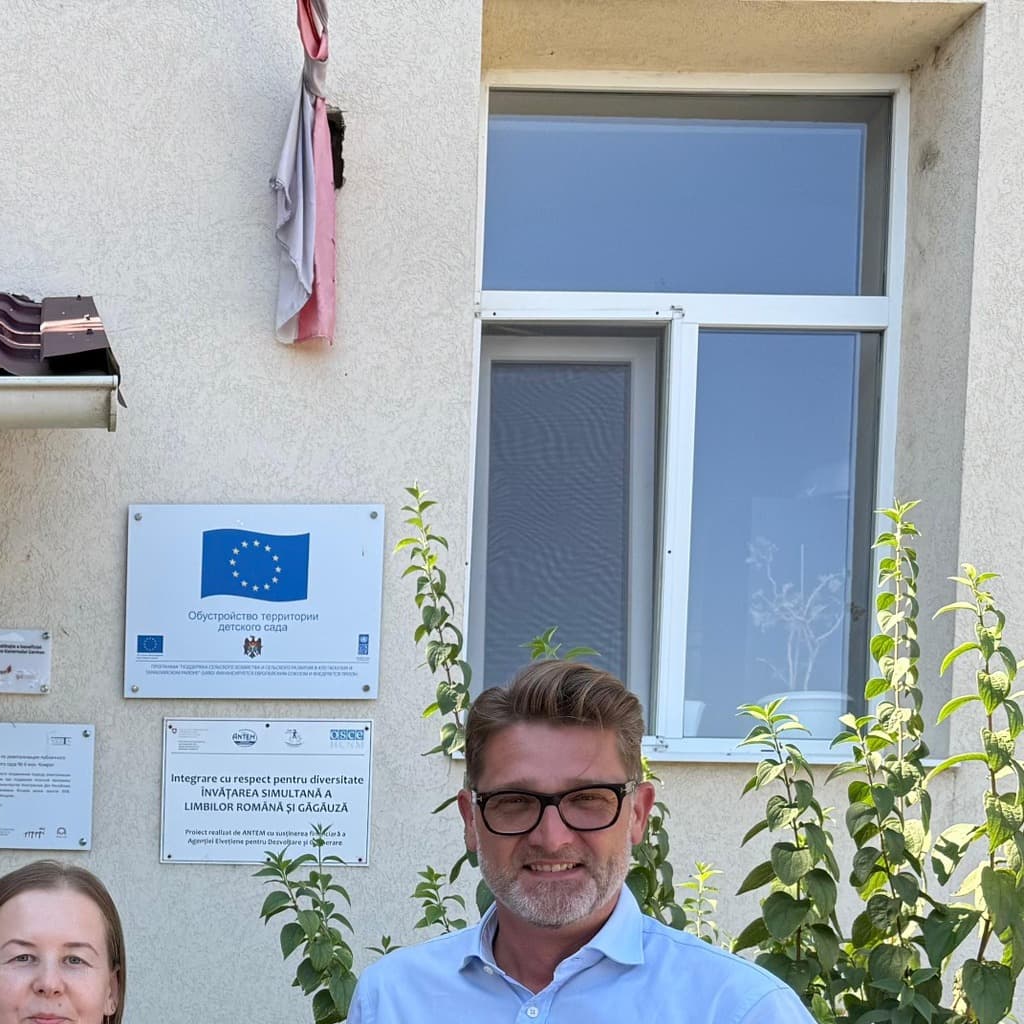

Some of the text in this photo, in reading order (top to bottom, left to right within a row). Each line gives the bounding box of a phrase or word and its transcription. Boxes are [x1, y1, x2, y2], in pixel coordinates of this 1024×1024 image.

[188, 610, 318, 622] Обустройство территории
[218, 624, 288, 632] детского сада
[232, 732, 256, 740] ANTEM
[171, 774, 218, 785] Integrare
[233, 775, 271, 785] respect
[273, 776, 307, 785] pentru
[310, 774, 364, 784] diversitate
[261, 788, 322, 798] SIMULTANĂ
[324, 790, 332, 798] A
[184, 802, 234, 811] LIMBILOR
[236, 801, 284, 812] ROMÂNĂ
[298, 802, 349, 812] GĂGĂUZĂ
